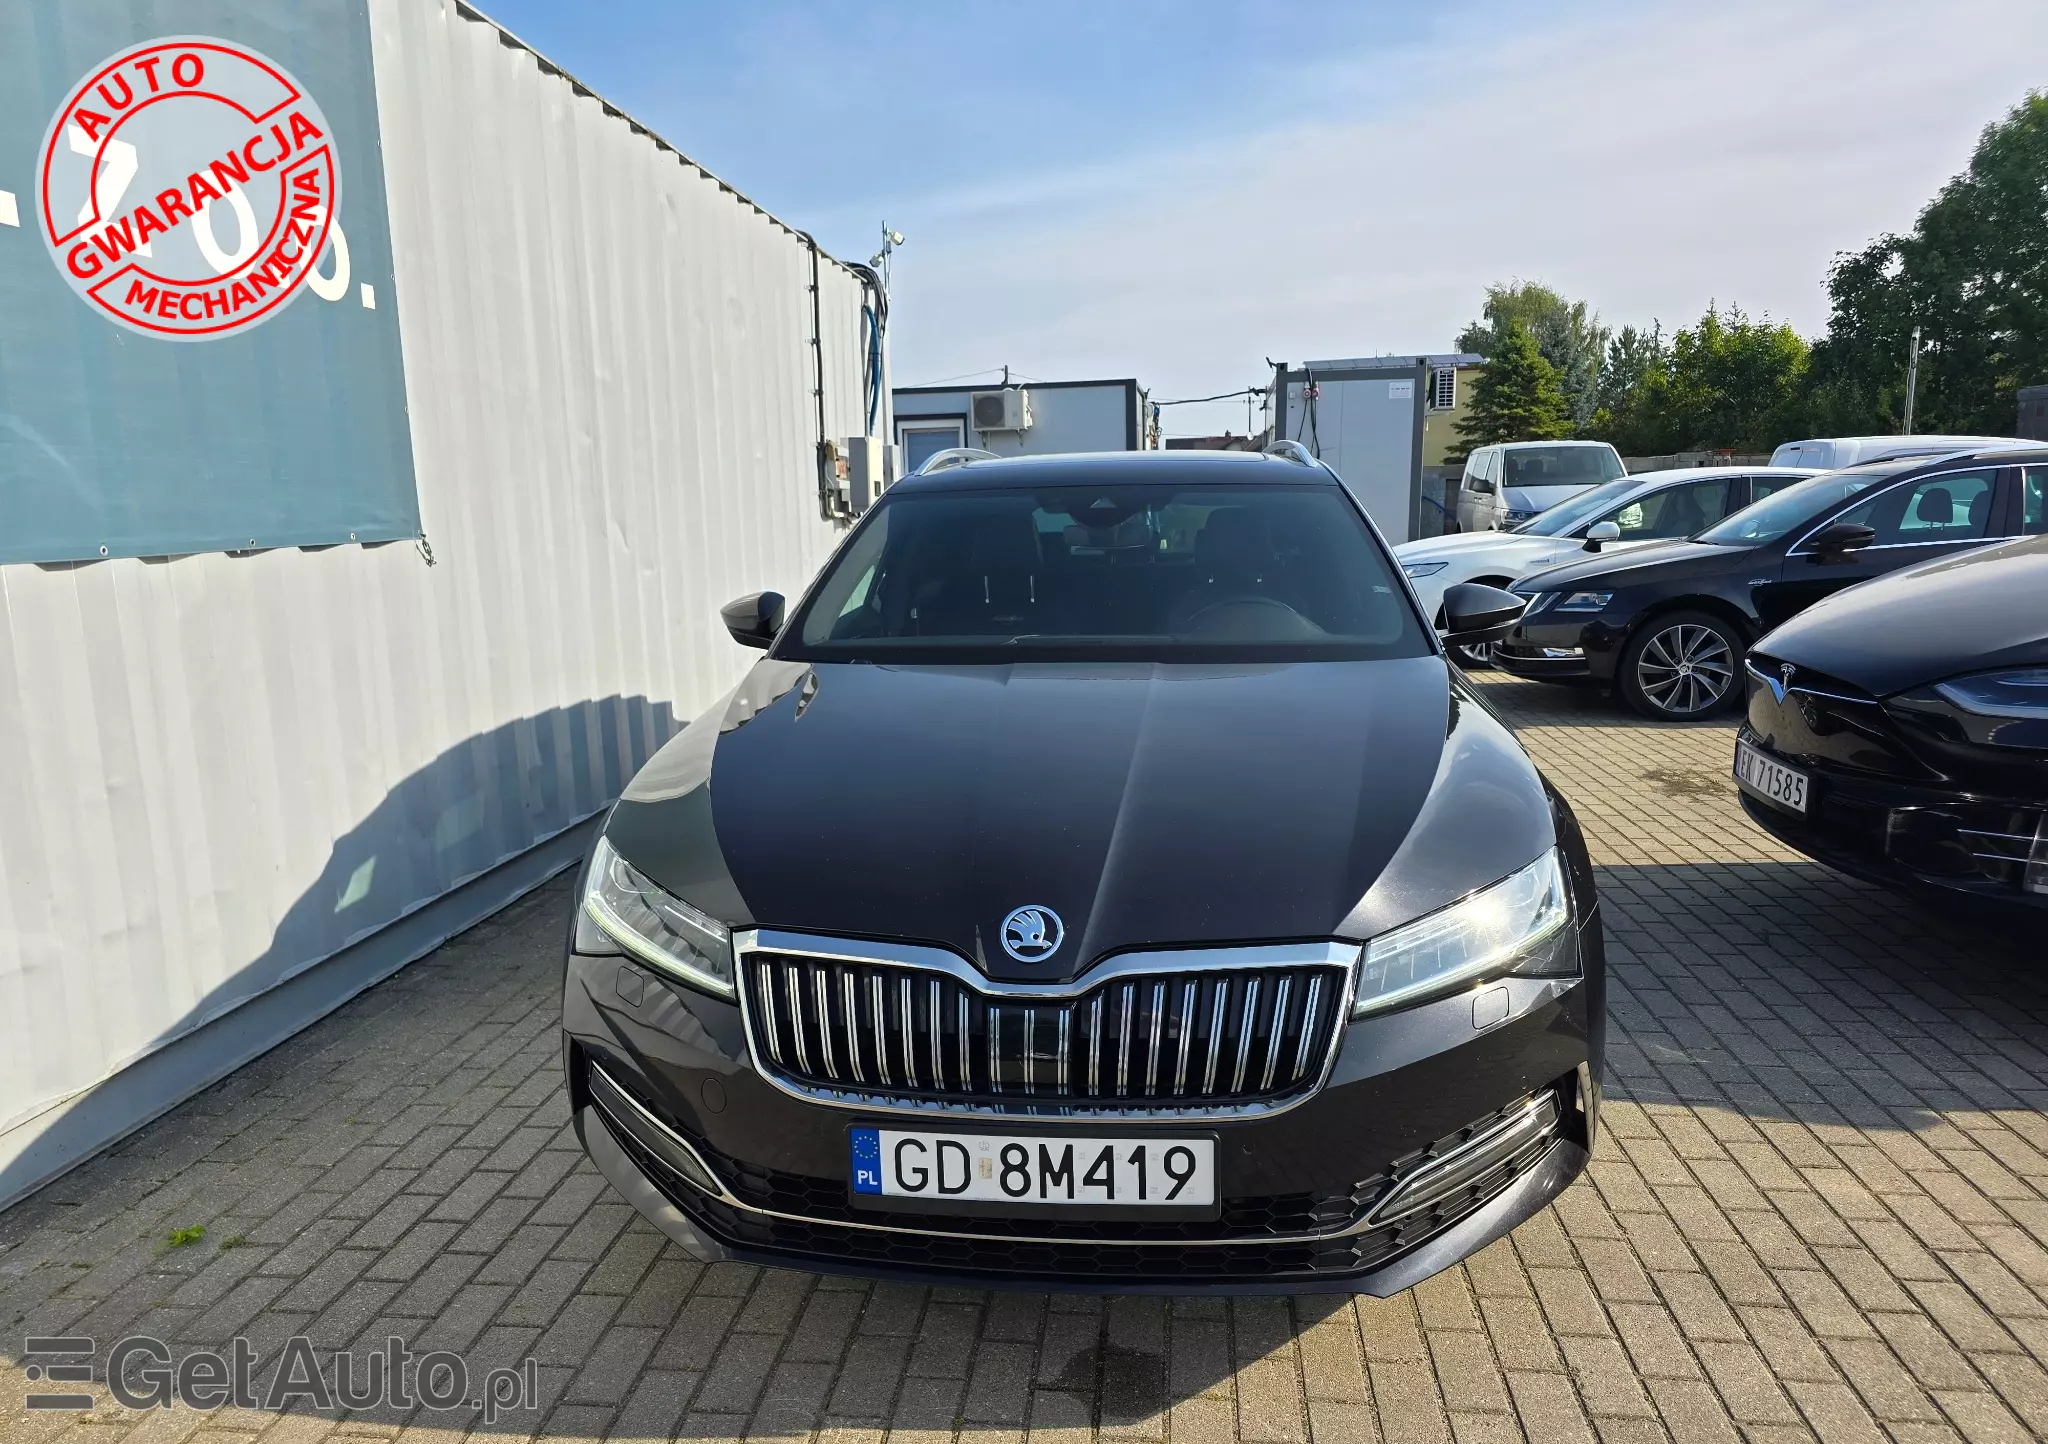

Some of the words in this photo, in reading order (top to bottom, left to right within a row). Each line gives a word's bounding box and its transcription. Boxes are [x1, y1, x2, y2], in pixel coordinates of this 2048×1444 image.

[1757, 759, 1804, 806] 71585
[857, 1169, 878, 1186] PL
[894, 1138, 971, 1194] GD
[999, 1143, 1197, 1200] 8M419
